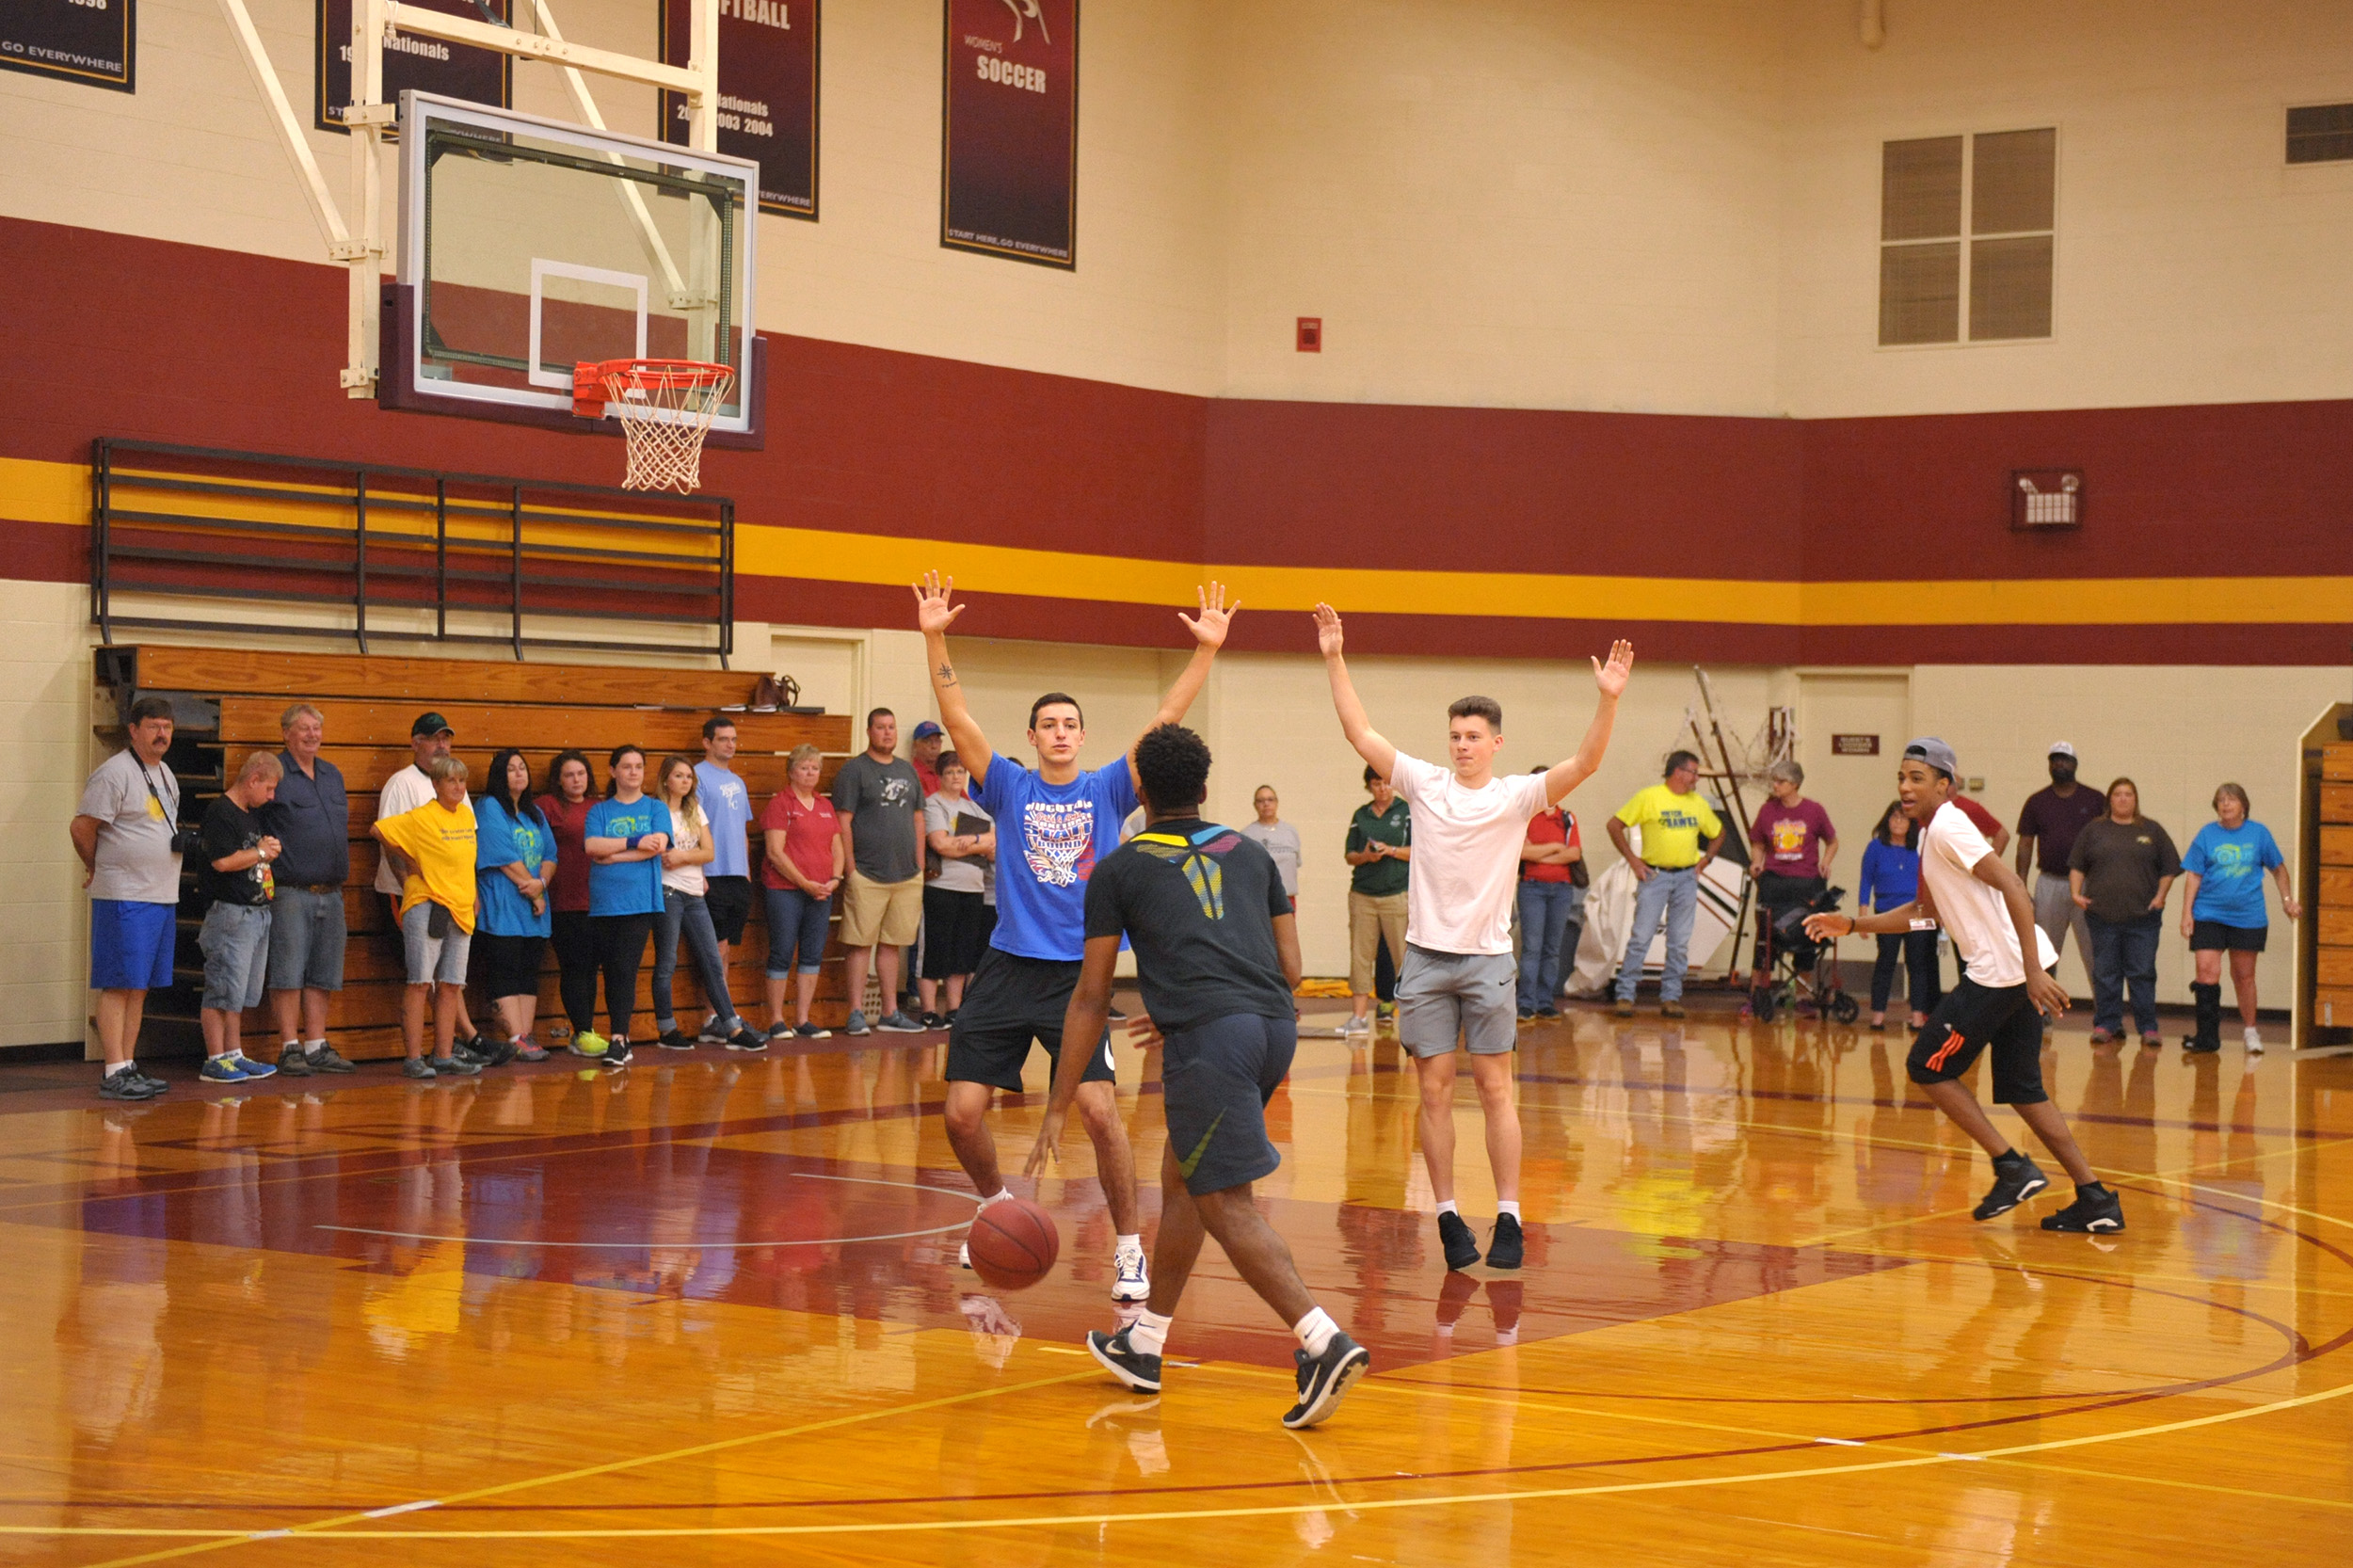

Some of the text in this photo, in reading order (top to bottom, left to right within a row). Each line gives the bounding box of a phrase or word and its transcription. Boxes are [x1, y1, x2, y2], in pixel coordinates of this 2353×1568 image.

[2, 40, 122, 72] GO EVERYWHERE
[977, 55, 1047, 94] SOCCER
[717, 112, 741, 131] 003
[744, 118, 774, 137] 2004
[948, 229, 974, 240] START
[1015, 241, 1068, 258] EVERYWHERE
[1037, 840, 1081, 848] BOUND
